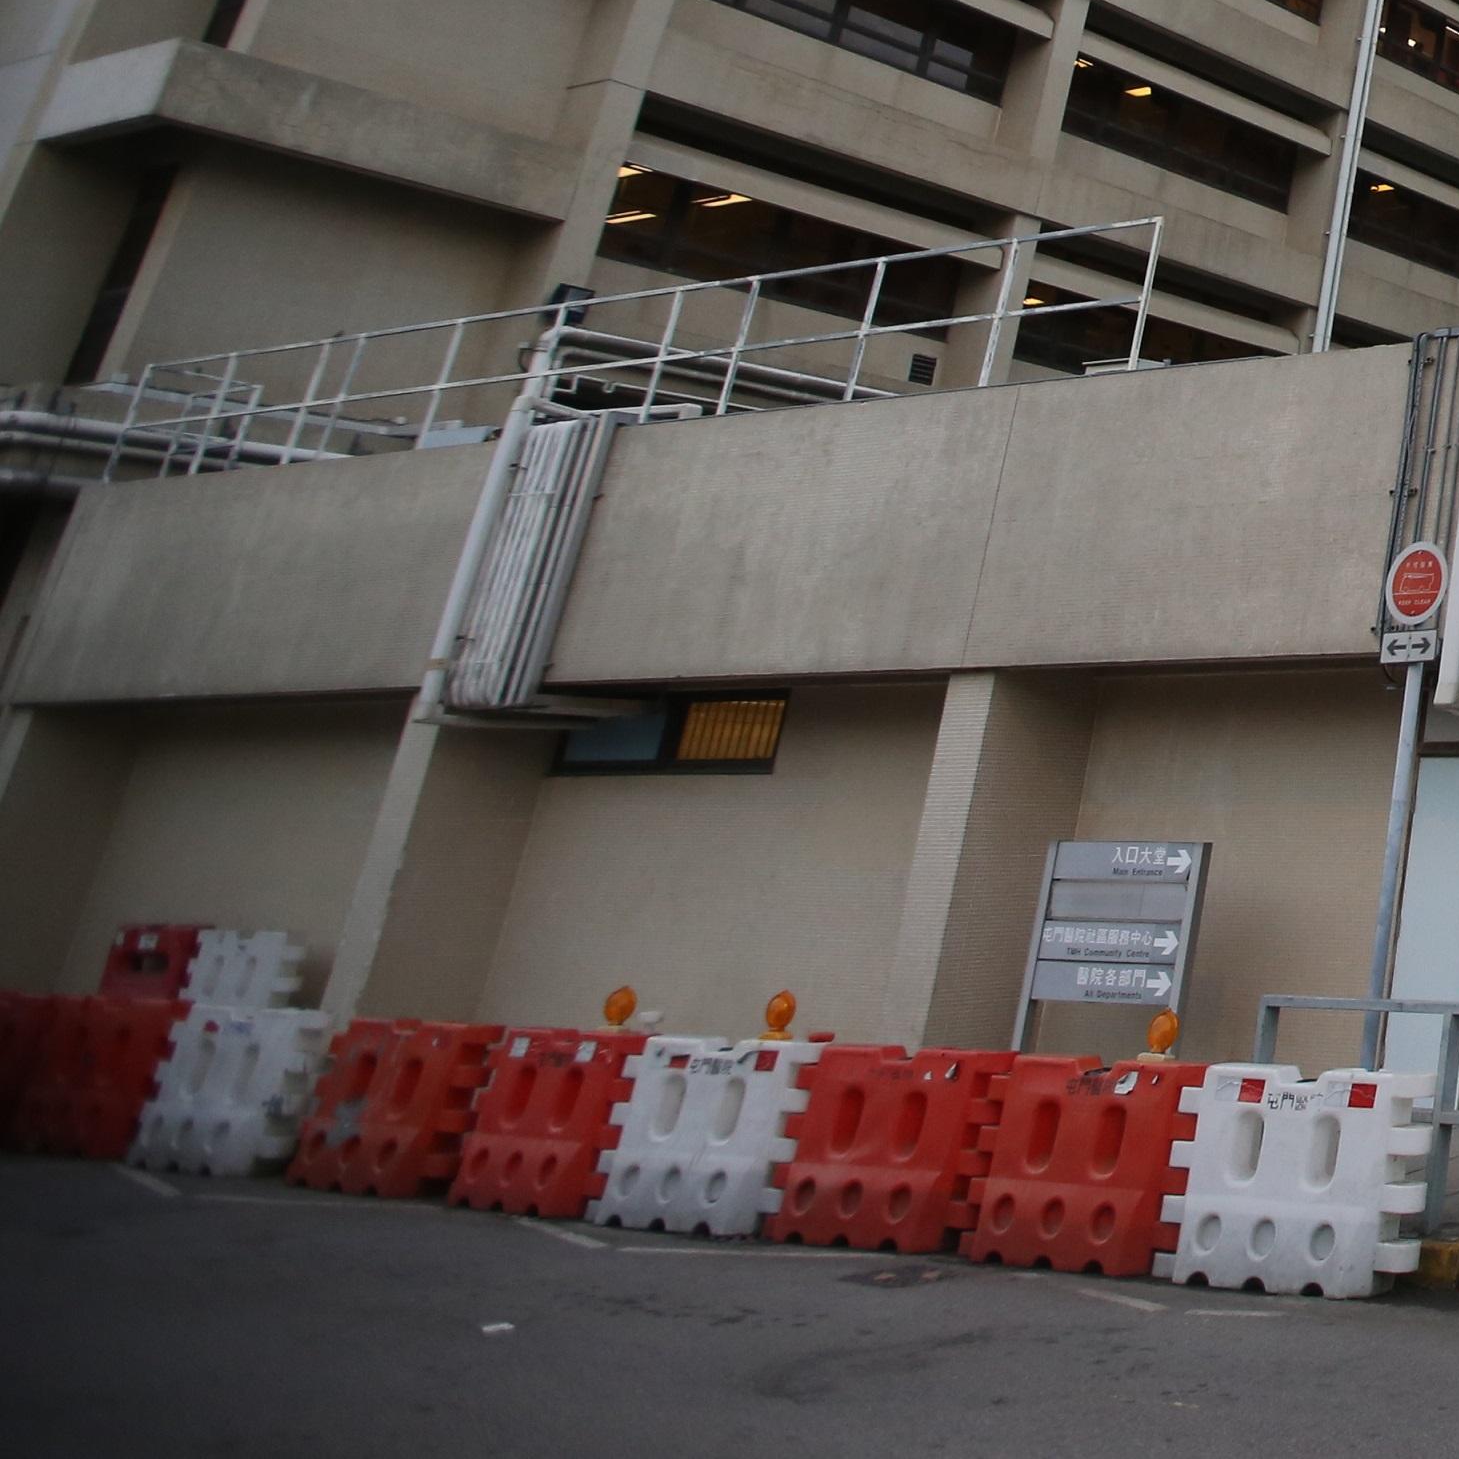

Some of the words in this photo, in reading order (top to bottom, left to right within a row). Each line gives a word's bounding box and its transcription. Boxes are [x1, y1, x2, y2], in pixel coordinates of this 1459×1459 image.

[1111, 846, 1167, 866] 入口大堂
[1112, 867, 1129, 875] Main
[1132, 868, 1163, 876] Entrance
[1084, 948, 1122, 958] Community
[1127, 949, 1150, 958] Centre
[1076, 966, 1147, 988] 醫院各部門
[1097, 990, 1142, 1000] Departments
